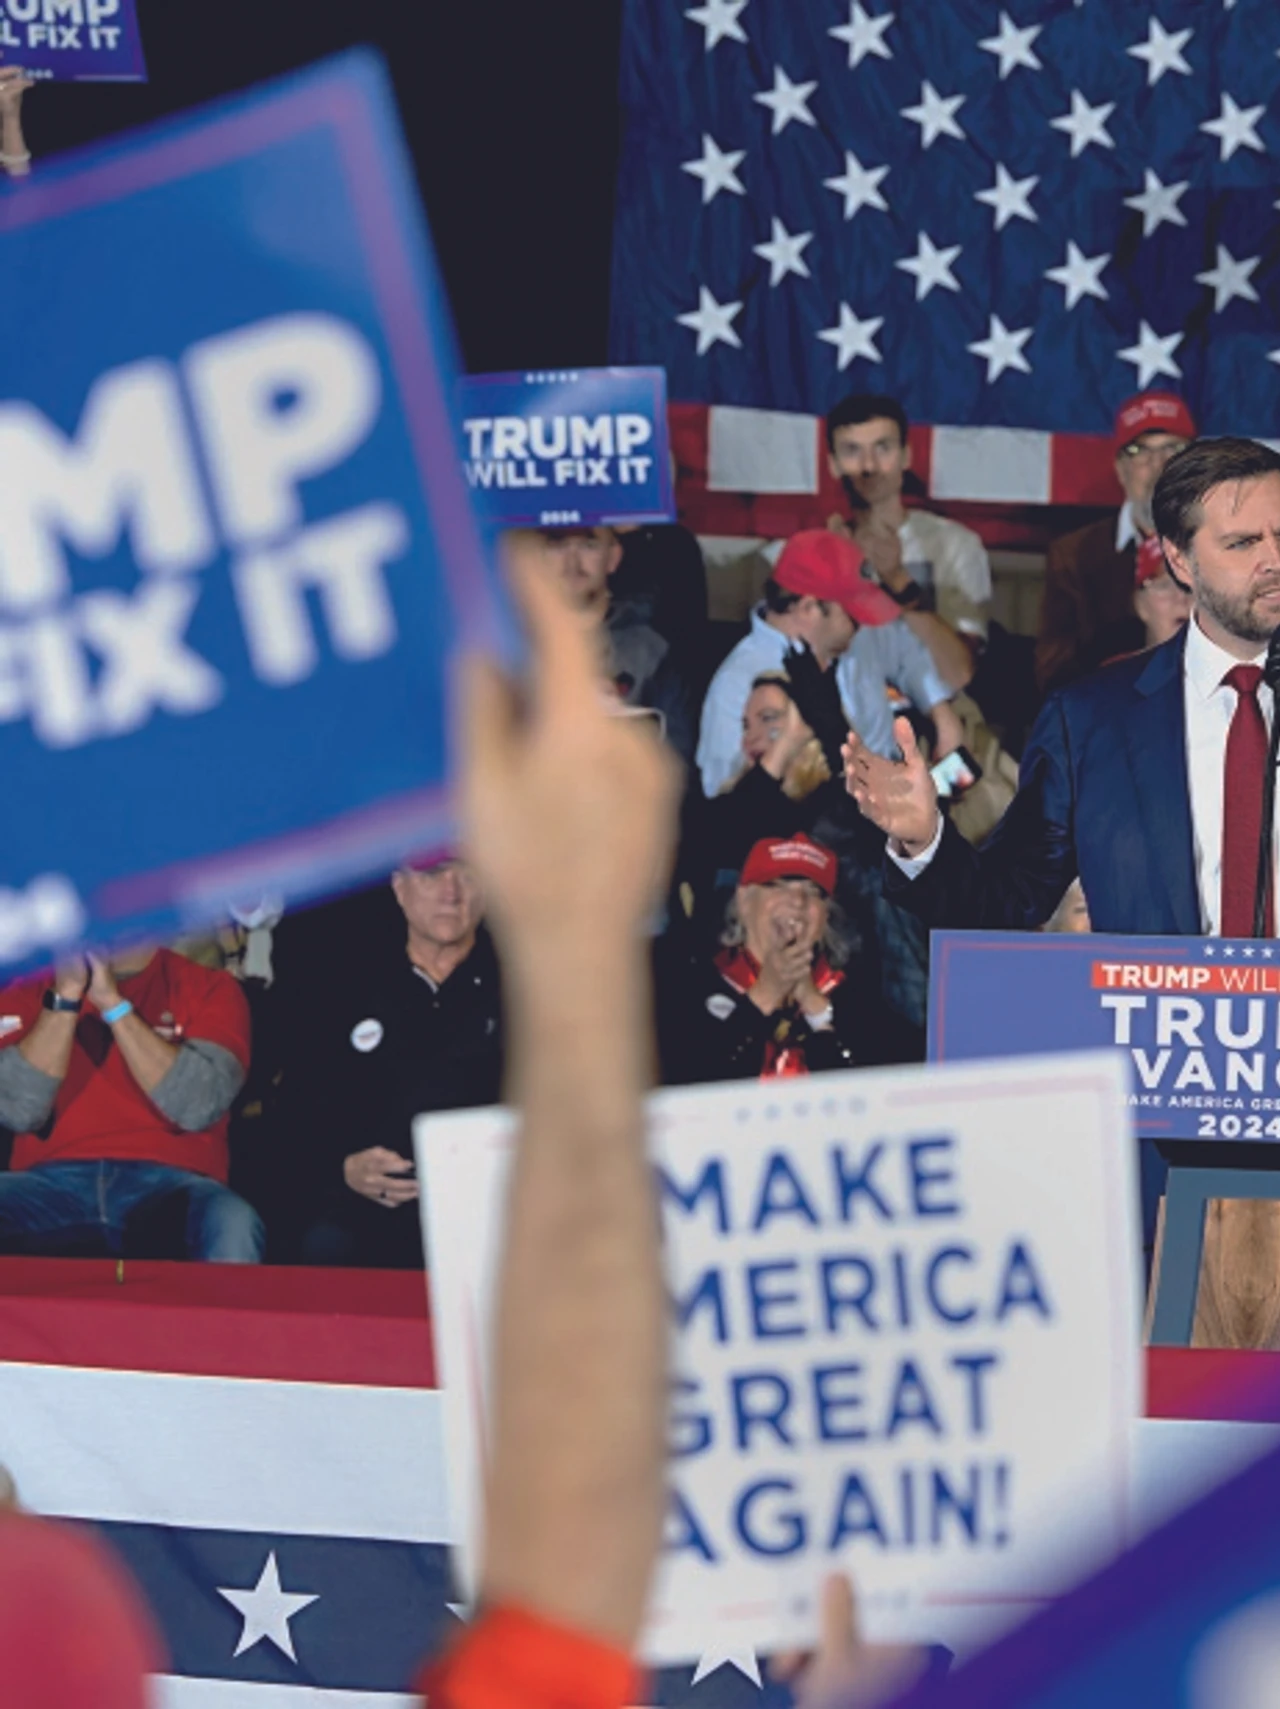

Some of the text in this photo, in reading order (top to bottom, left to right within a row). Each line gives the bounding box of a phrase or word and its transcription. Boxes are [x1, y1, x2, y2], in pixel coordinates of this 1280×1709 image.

[0, 0, 120, 25] UMP
[28, 23, 82, 49] FIX
[89, 26, 121, 50] IT
[463, 414, 652, 459] TRUMP
[465, 457, 652, 489] WILL FIX IT
[231, 498, 410, 686] IT
[1102, 964, 1211, 989] TRUMP
[1121, 1095, 1163, 1108] AKE
[1168, 1094, 1244, 1110] AMERICA
[654, 1134, 961, 1234] MAKE
[670, 1241, 1052, 1348] MERICA
[664, 1462, 1009, 1563] AGAIN!
